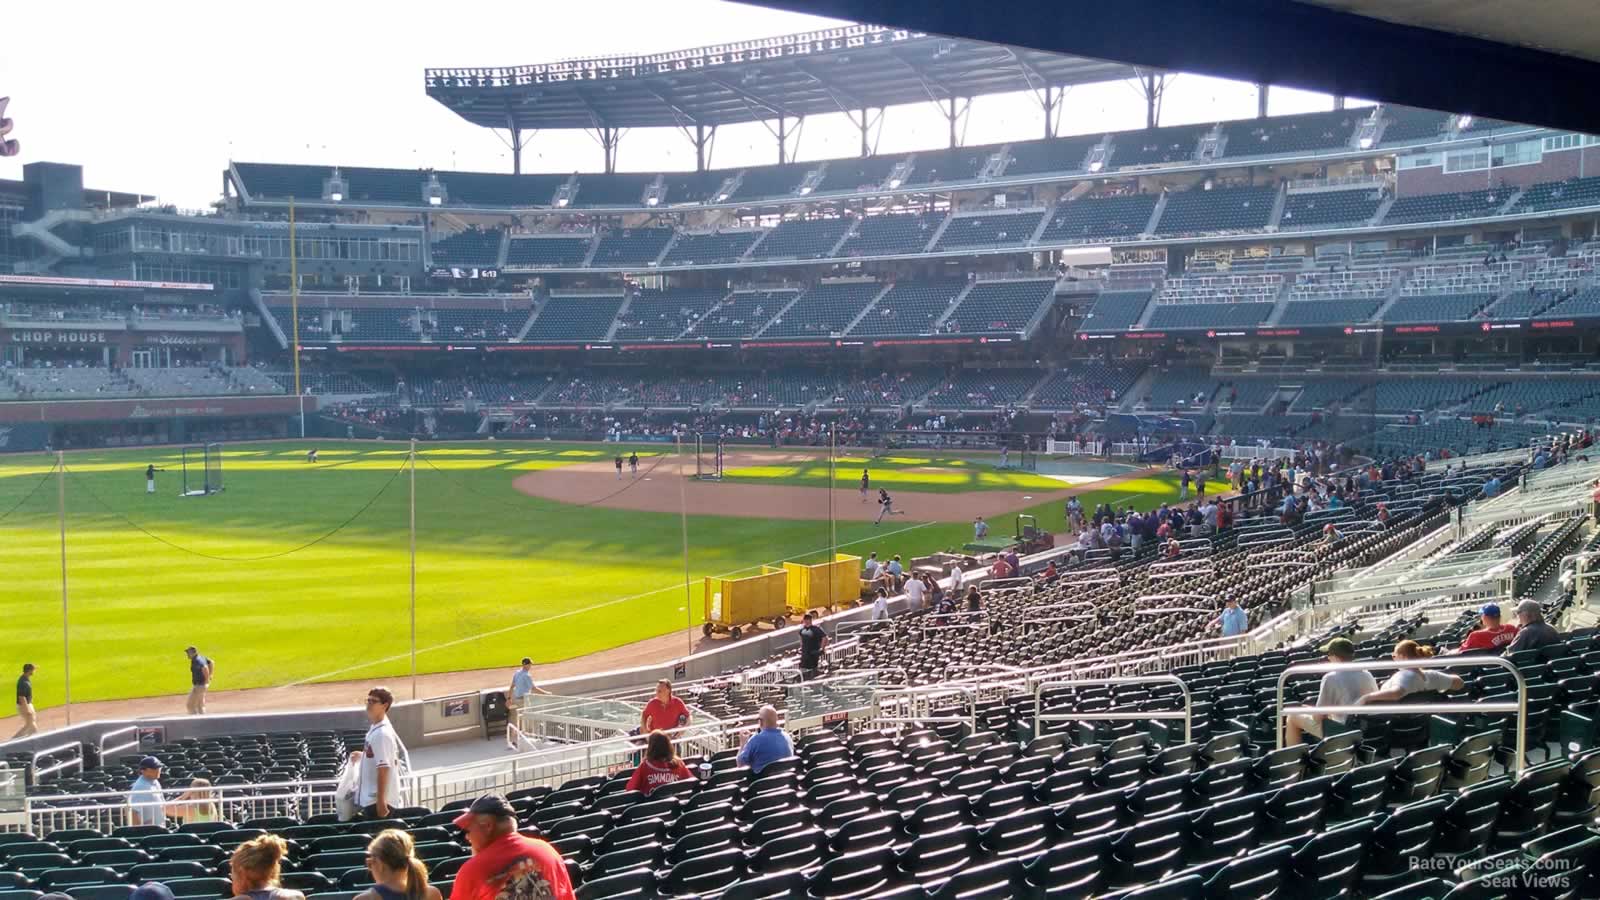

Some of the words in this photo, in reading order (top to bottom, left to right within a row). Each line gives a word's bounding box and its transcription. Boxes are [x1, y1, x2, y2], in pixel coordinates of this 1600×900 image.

[12, 331, 52, 343] CHOP
[58, 332, 105, 343] HOUSE
[647, 772, 680, 785] SIMMONS
